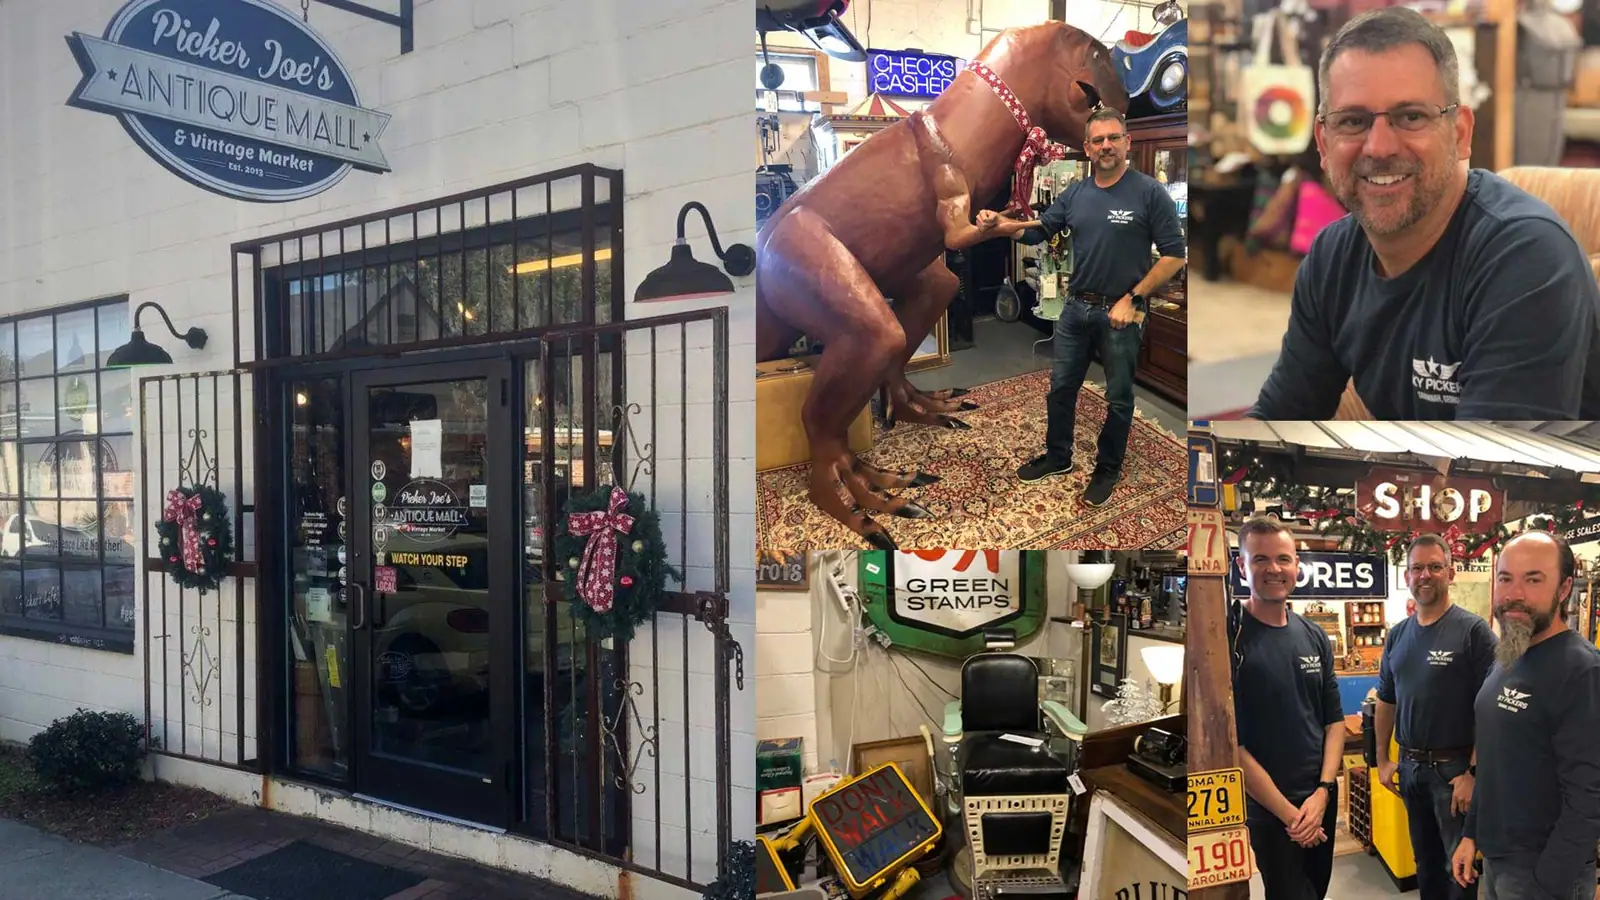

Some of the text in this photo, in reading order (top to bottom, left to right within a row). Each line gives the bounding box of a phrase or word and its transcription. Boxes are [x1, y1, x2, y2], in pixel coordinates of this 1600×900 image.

[152, 8, 334, 91] Picker Joe's
[874, 54, 954, 78] CHECKS
[121, 62, 362, 152] ANTIQUE MALL
[174, 129, 315, 173] & Vintage Market
[228, 162, 264, 177] Est. 2013
[401, 489, 427, 505] Picker
[428, 490, 452, 505] Joe's
[1374, 481, 1493, 523] SHOP
[393, 510, 434, 523] ANTIQUE
[435, 510, 460, 523] MALL
[391, 552, 468, 568] WATCH YOUR STEP
[375, 580, 397, 592] LOCAL
[907, 578, 1009, 593] GREEN
[907, 594, 1010, 611] STAMPS
[1188, 776, 1214, 788] OMA
[819, 771, 896, 826] DONT
[1187, 787, 1230, 818] 279
[833, 790, 914, 849] WALK
